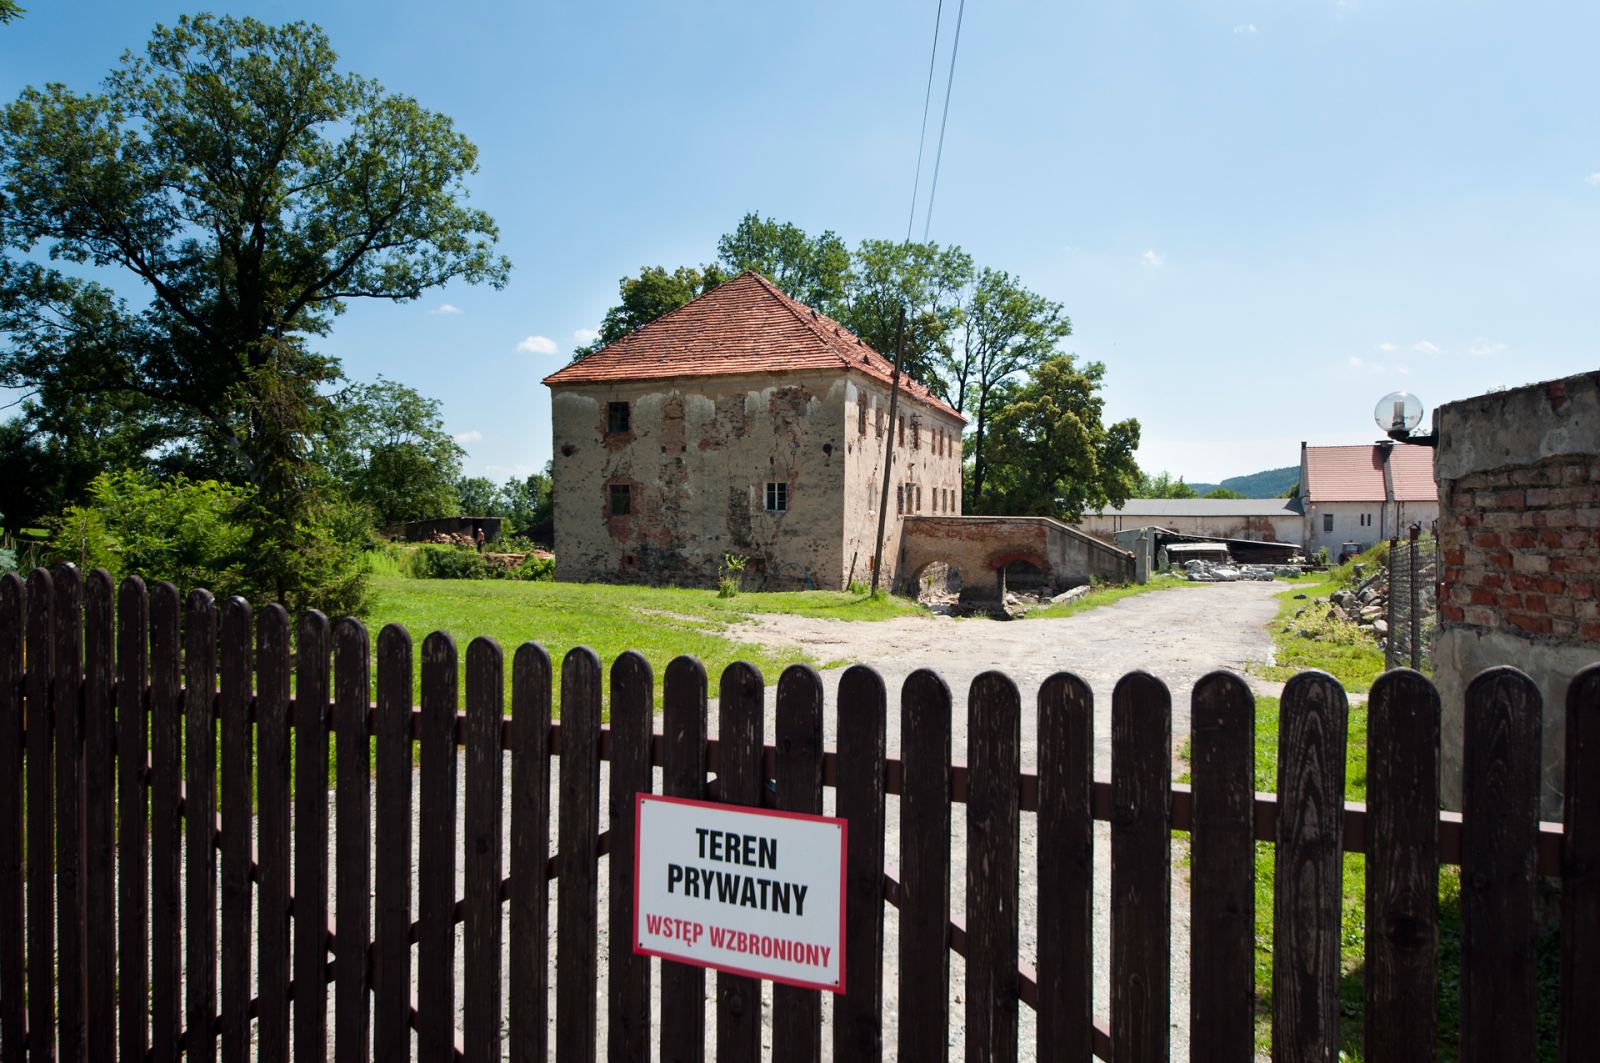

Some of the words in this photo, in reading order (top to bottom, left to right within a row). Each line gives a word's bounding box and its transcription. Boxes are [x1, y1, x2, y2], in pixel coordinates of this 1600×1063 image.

[695, 828, 777, 870] TEREN
[667, 863, 808, 916] PRYWATNY
[646, 913, 703, 947] WSTĘP
[709, 926, 831, 968] WZBRONIONY
